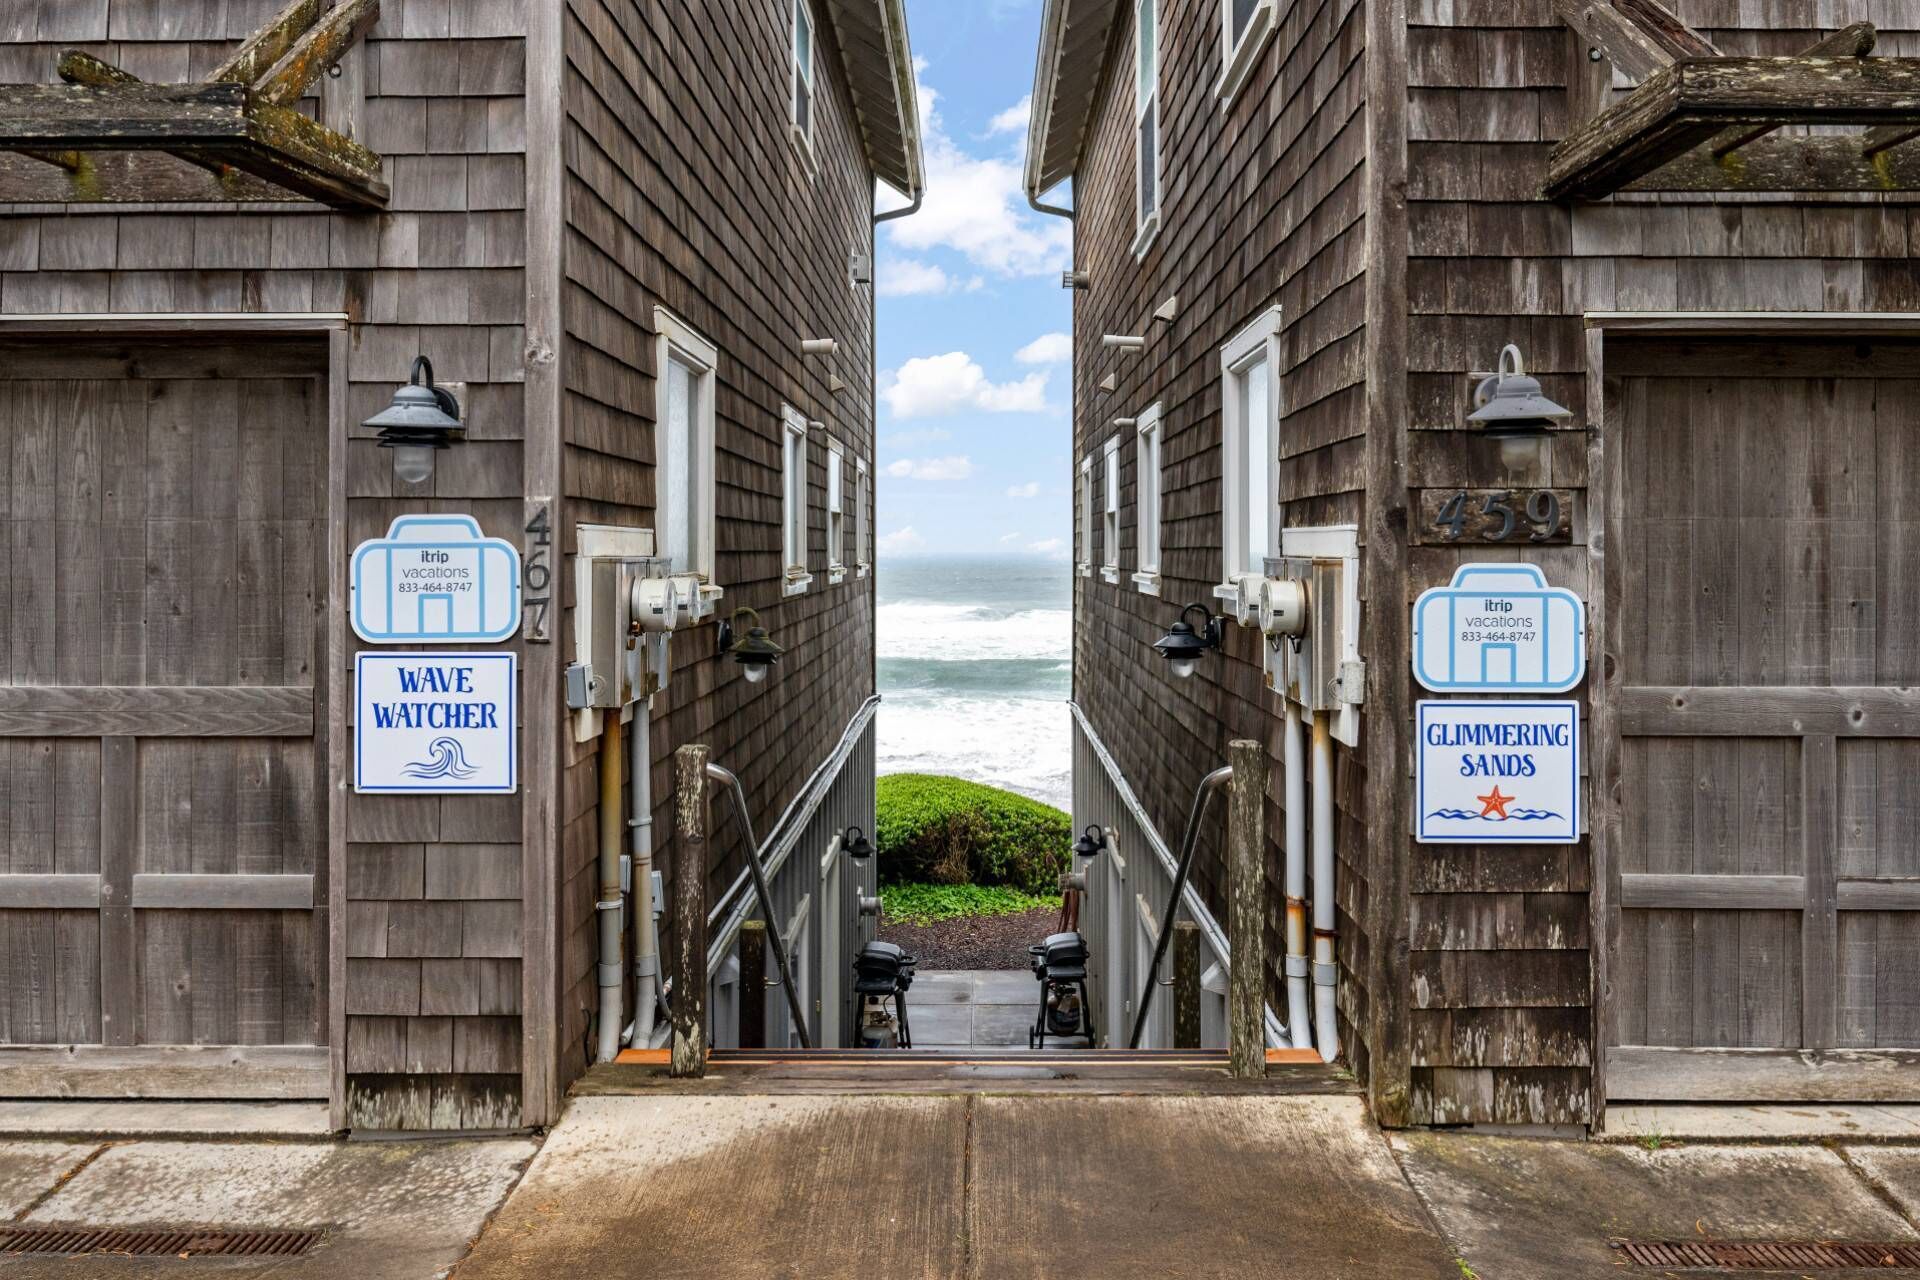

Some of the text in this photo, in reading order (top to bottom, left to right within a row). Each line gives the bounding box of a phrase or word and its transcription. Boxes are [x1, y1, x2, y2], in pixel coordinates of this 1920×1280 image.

[1436, 490, 1560, 542] 459
[421, 551, 449, 564] itrip
[402, 566, 469, 579] vacations
[525, 506, 550, 637] 467
[399, 582, 472, 592] 833-464-8747
[1485, 599, 1513, 613] itrip
[1465, 615, 1533, 628] vacations
[1461, 631, 1536, 642] 833-464-8747
[397, 667, 474, 693] WAVE
[372, 702, 498, 729] WATCHER
[1427, 723, 1569, 748] GLIMMERING
[1460, 754, 1536, 777] SANDS
